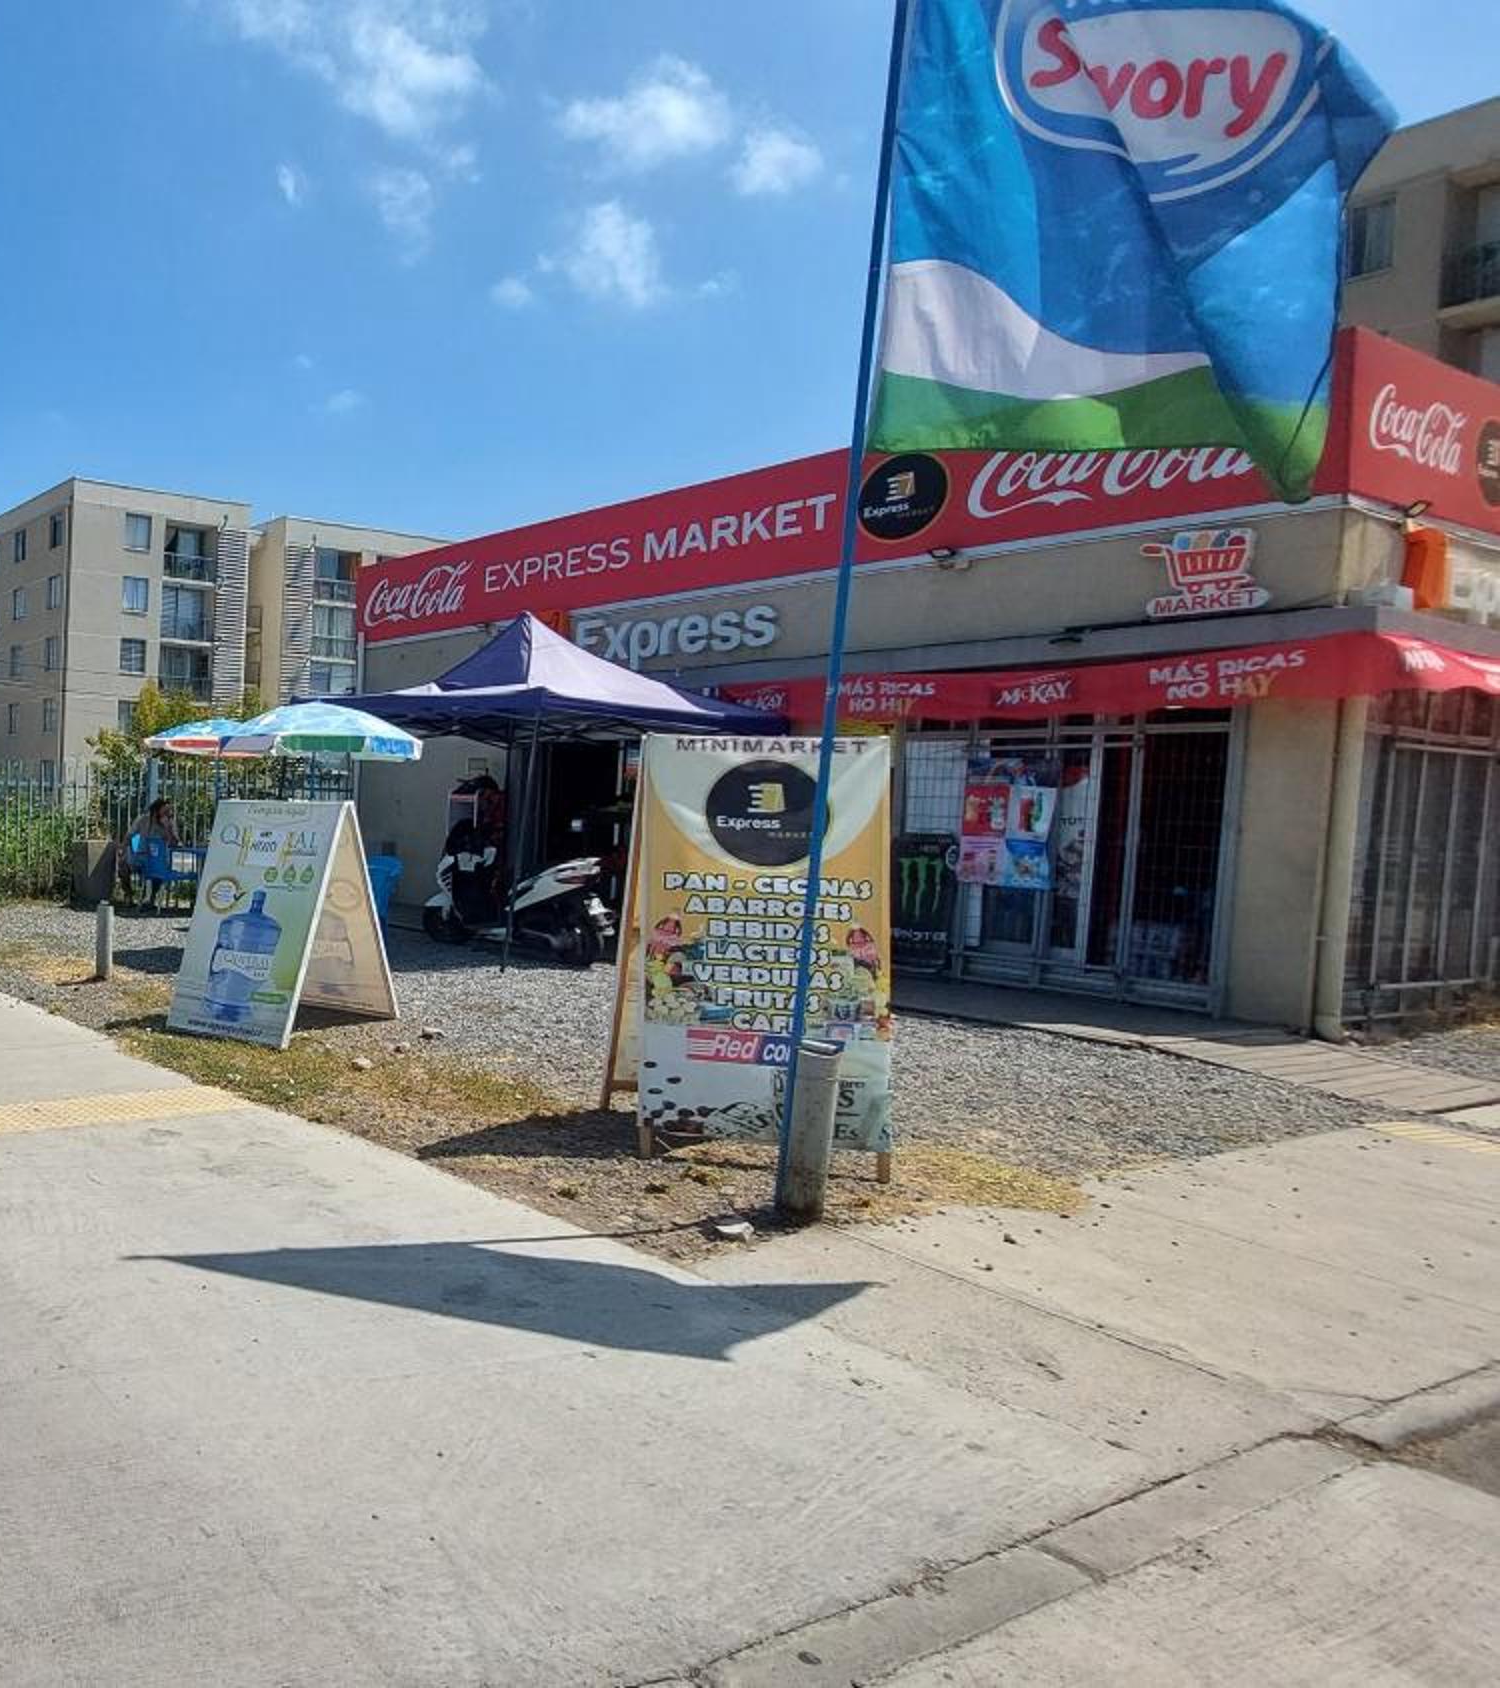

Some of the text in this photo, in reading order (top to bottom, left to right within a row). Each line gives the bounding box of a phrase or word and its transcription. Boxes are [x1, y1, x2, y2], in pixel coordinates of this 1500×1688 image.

[1029, 17, 1288, 139] Svory
[863, 502, 909, 519] Express
[483, 493, 837, 593] EXPRESS MARKET
[1153, 590, 1258, 615] MARKET
[574, 604, 779, 671] Express
[1150, 650, 1306, 684] MÁS RICAS
[1167, 671, 1277, 700] NO HAY
[716, 815, 781, 830] Express
[664, 872, 728, 891] PAN
[752, 876, 873, 900] CECNAS
[731, 1011, 795, 1034] CAF
[711, 1034, 758, 1059] Red
